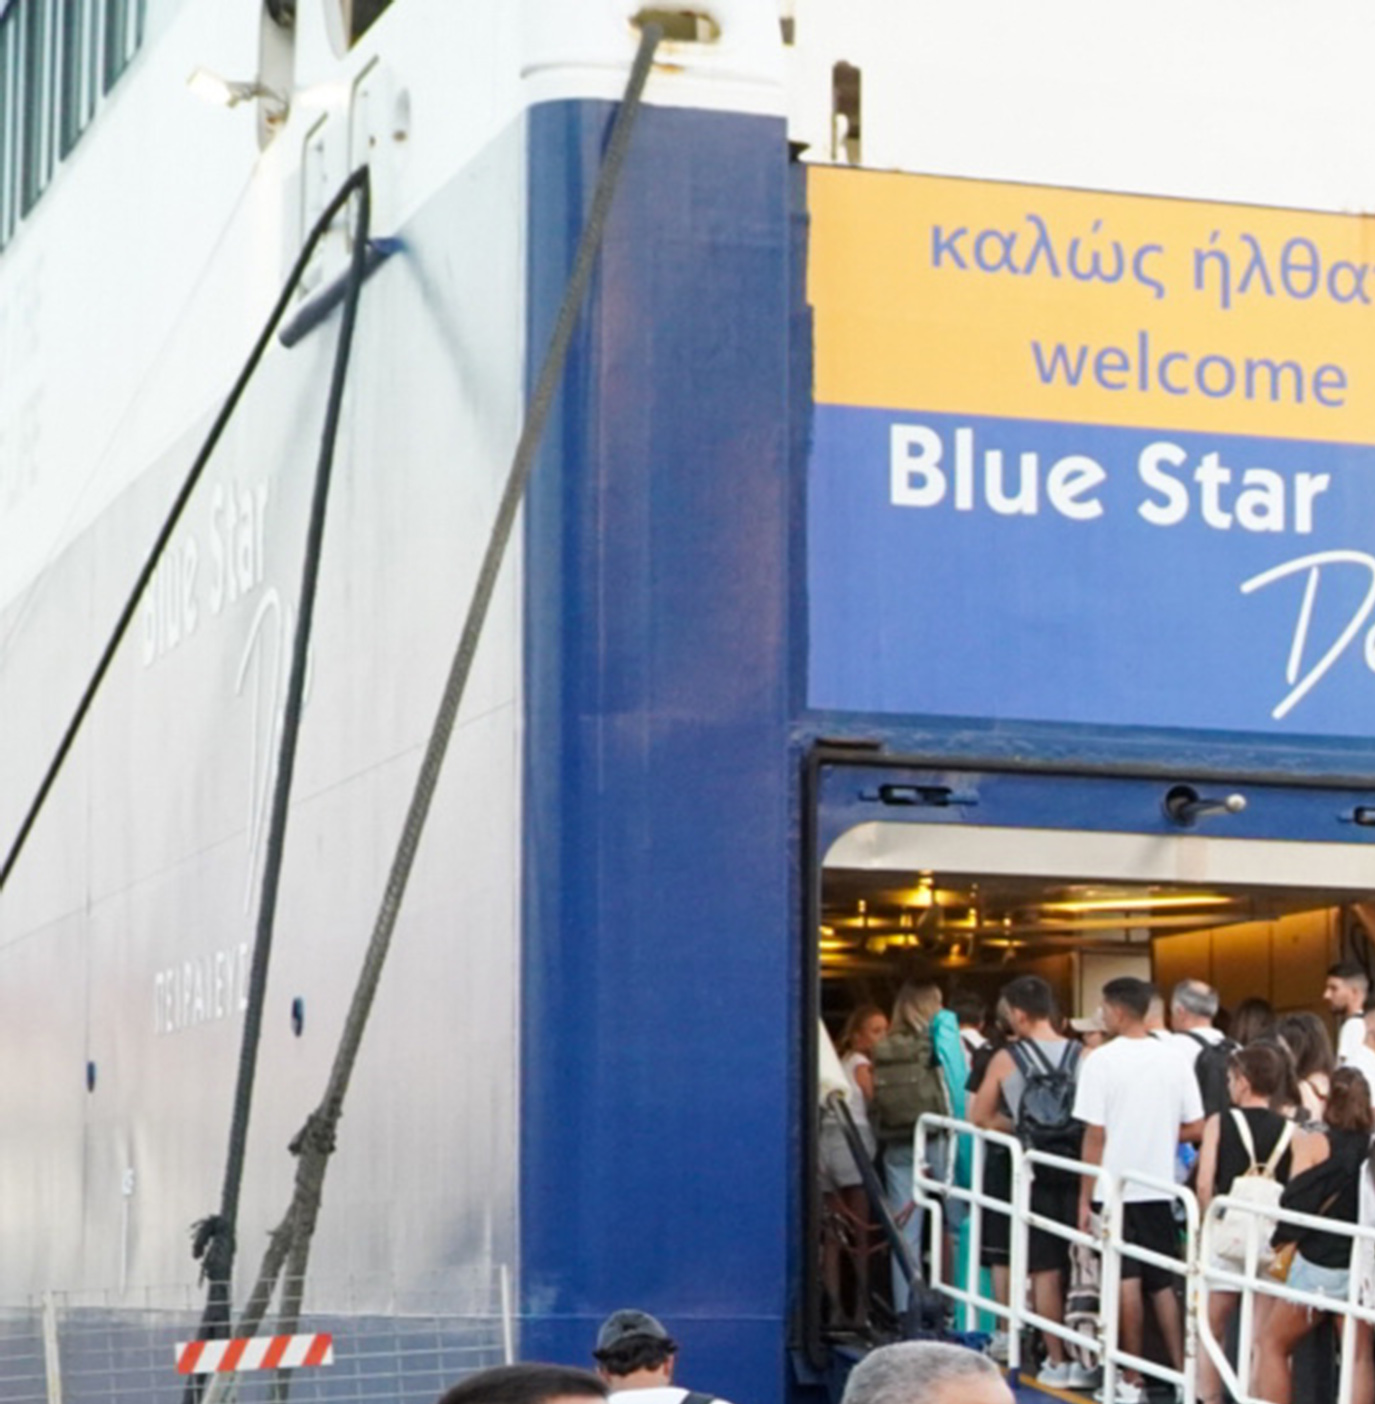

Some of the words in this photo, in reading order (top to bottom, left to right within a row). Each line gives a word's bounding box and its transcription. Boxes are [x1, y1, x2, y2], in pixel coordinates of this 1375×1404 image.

[930, 213, 1165, 299] καλώς
[1031, 330, 1348, 408] welcome
[888, 423, 1106, 520] Blue
[1137, 441, 1330, 534] Star
[209, 475, 270, 615] Star
